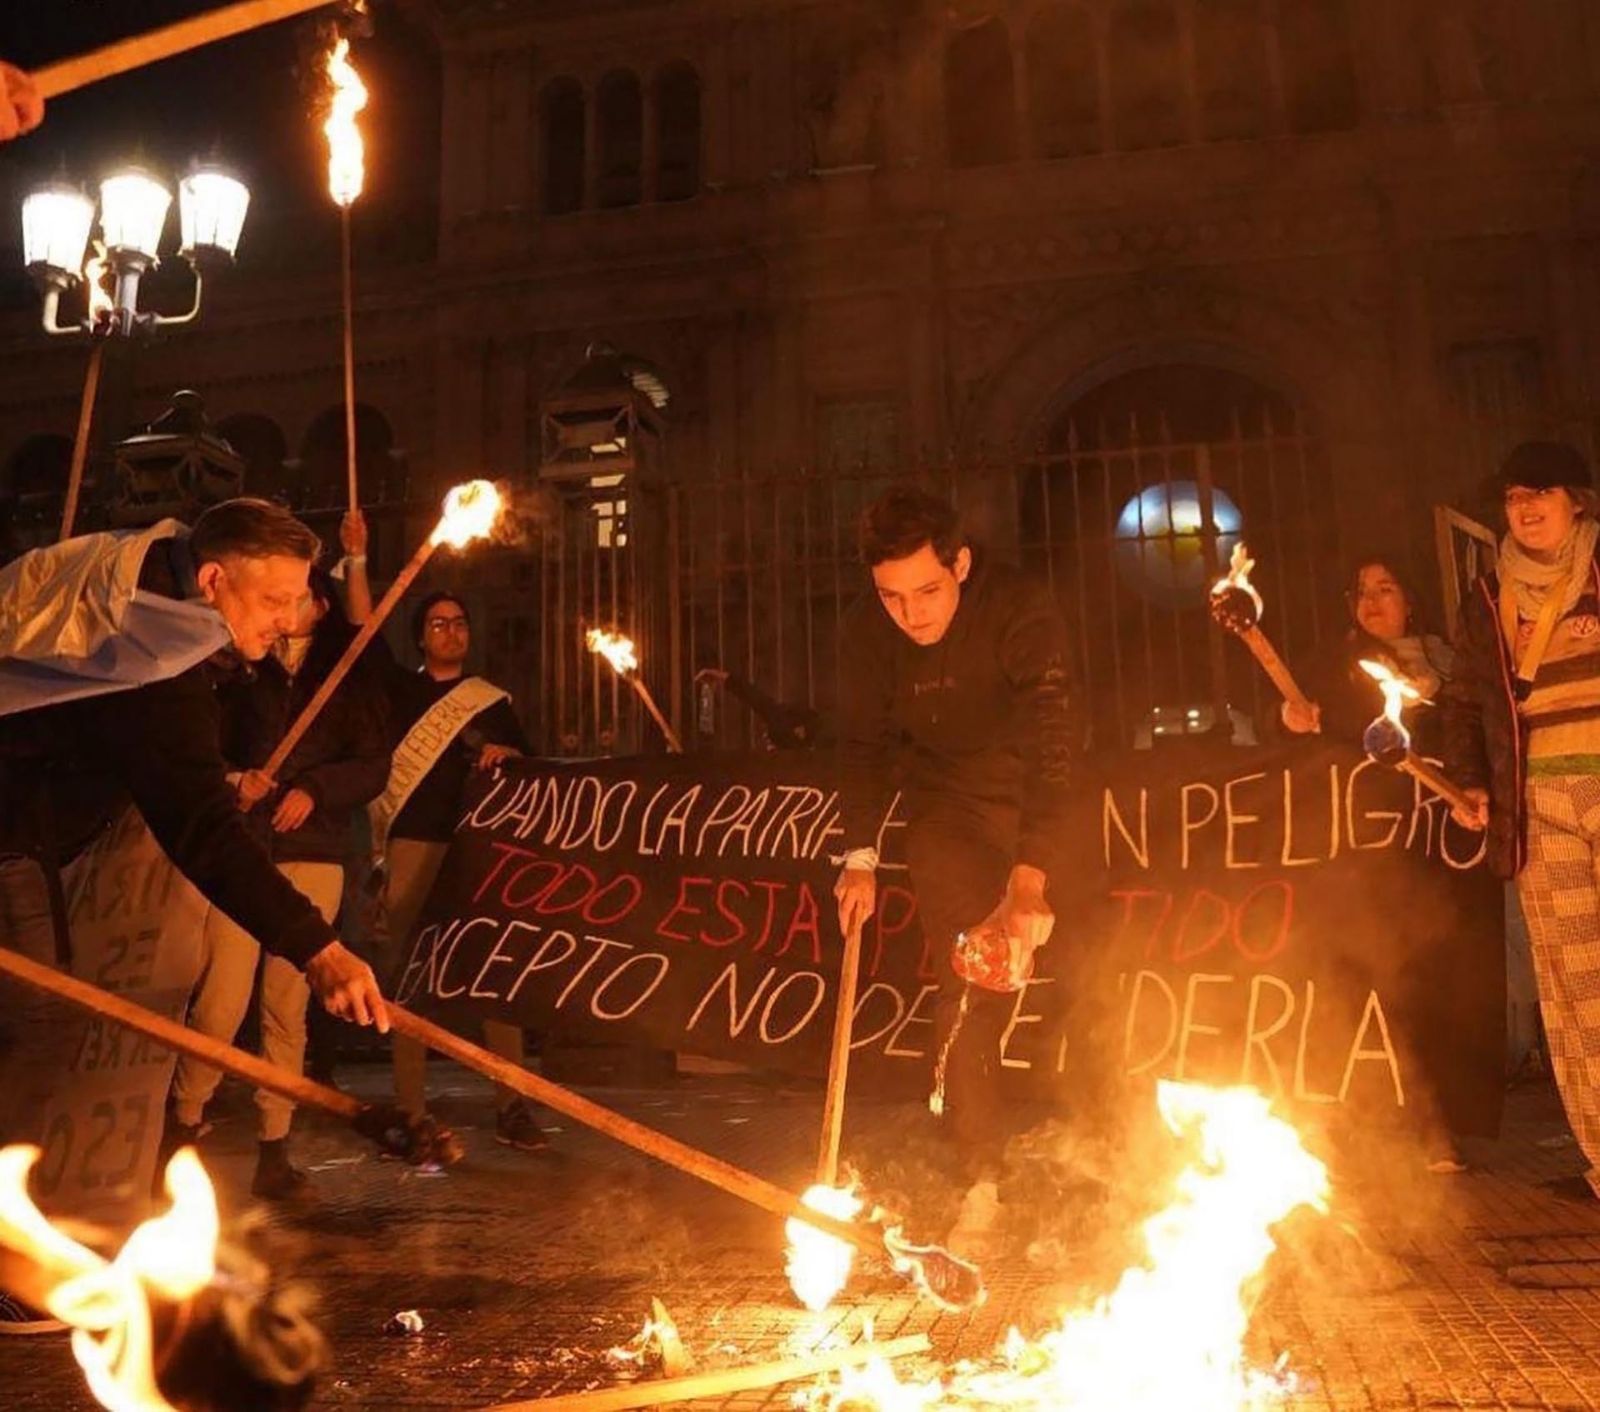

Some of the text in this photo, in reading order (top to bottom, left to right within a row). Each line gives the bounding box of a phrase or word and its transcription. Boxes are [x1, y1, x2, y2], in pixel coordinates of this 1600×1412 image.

[405, 697, 476, 762] FEDERAL
[637, 782, 702, 856] LA
[472, 842, 643, 926] TODO
[655, 877, 822, 963] ESTA
[395, 917, 670, 1020] EXCEPTO
[685, 962, 826, 1045] NO
